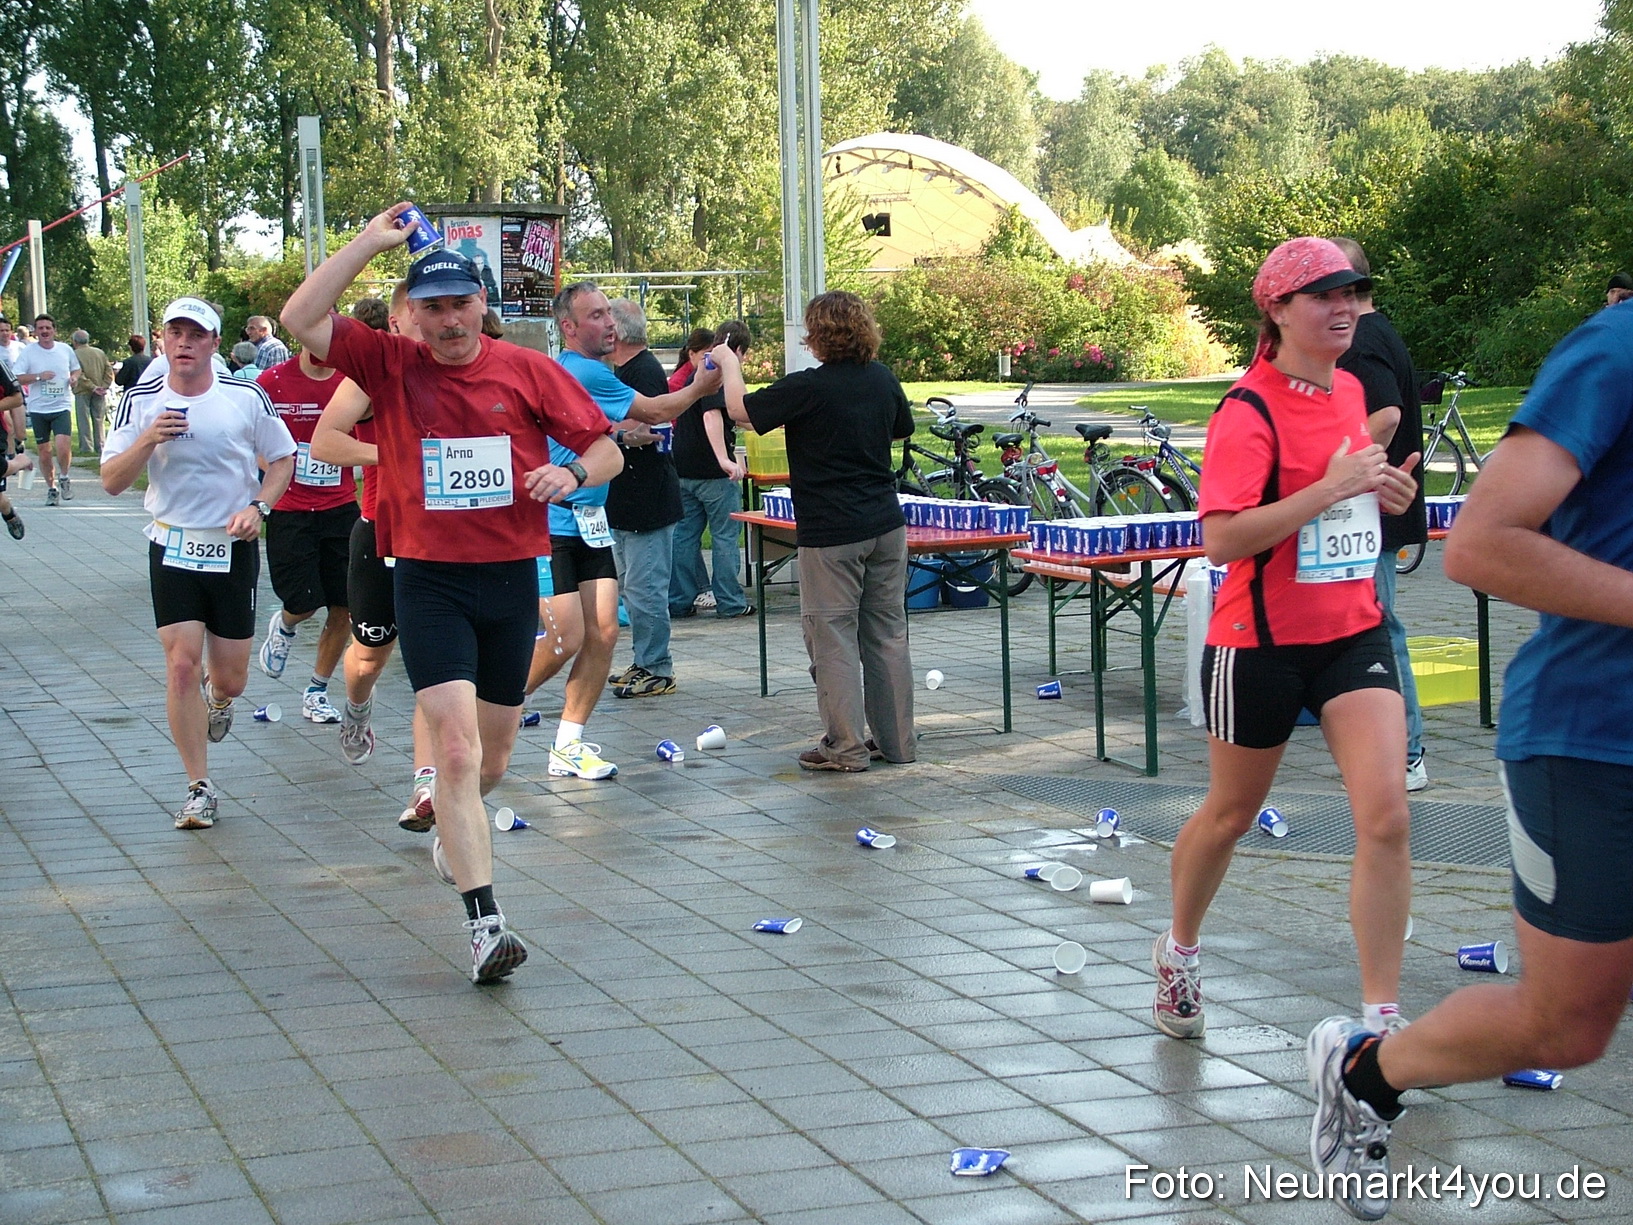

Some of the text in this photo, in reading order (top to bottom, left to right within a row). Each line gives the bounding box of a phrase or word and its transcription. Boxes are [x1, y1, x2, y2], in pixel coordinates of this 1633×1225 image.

[450, 220, 470, 228] Bruno
[447, 225, 484, 246] Jonas
[526, 234, 555, 262] ROCK
[446, 446, 474, 459] Arno
[310, 463, 339, 475] 2134
[427, 466, 434, 477] B
[449, 468, 505, 490] 2890
[186, 541, 227, 558] 3526
[1326, 530, 1377, 559] 3078
